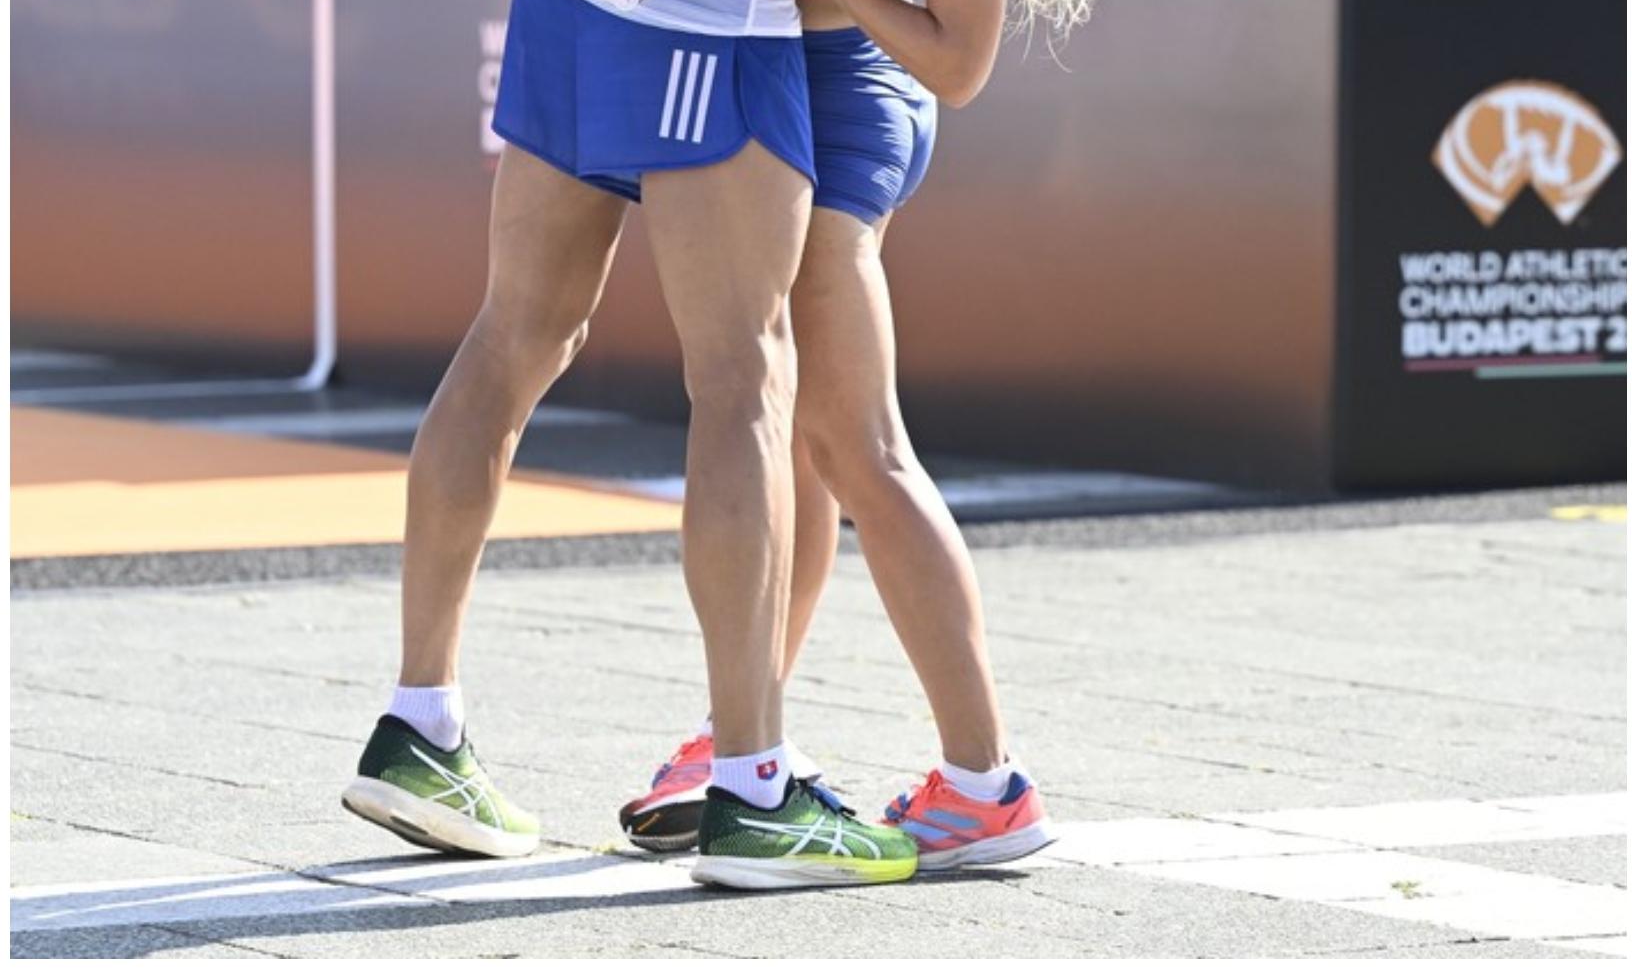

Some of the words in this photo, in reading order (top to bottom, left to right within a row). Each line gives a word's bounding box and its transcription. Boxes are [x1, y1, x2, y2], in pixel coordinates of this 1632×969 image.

[1400, 251, 1501, 283] WORLD
[1504, 248, 1627, 280] ATHLETIC
[1400, 281, 1627, 317] CHAMPIONSHIP
[1402, 318, 1600, 357] BUDAPEST
[1605, 316, 1627, 353] 2
